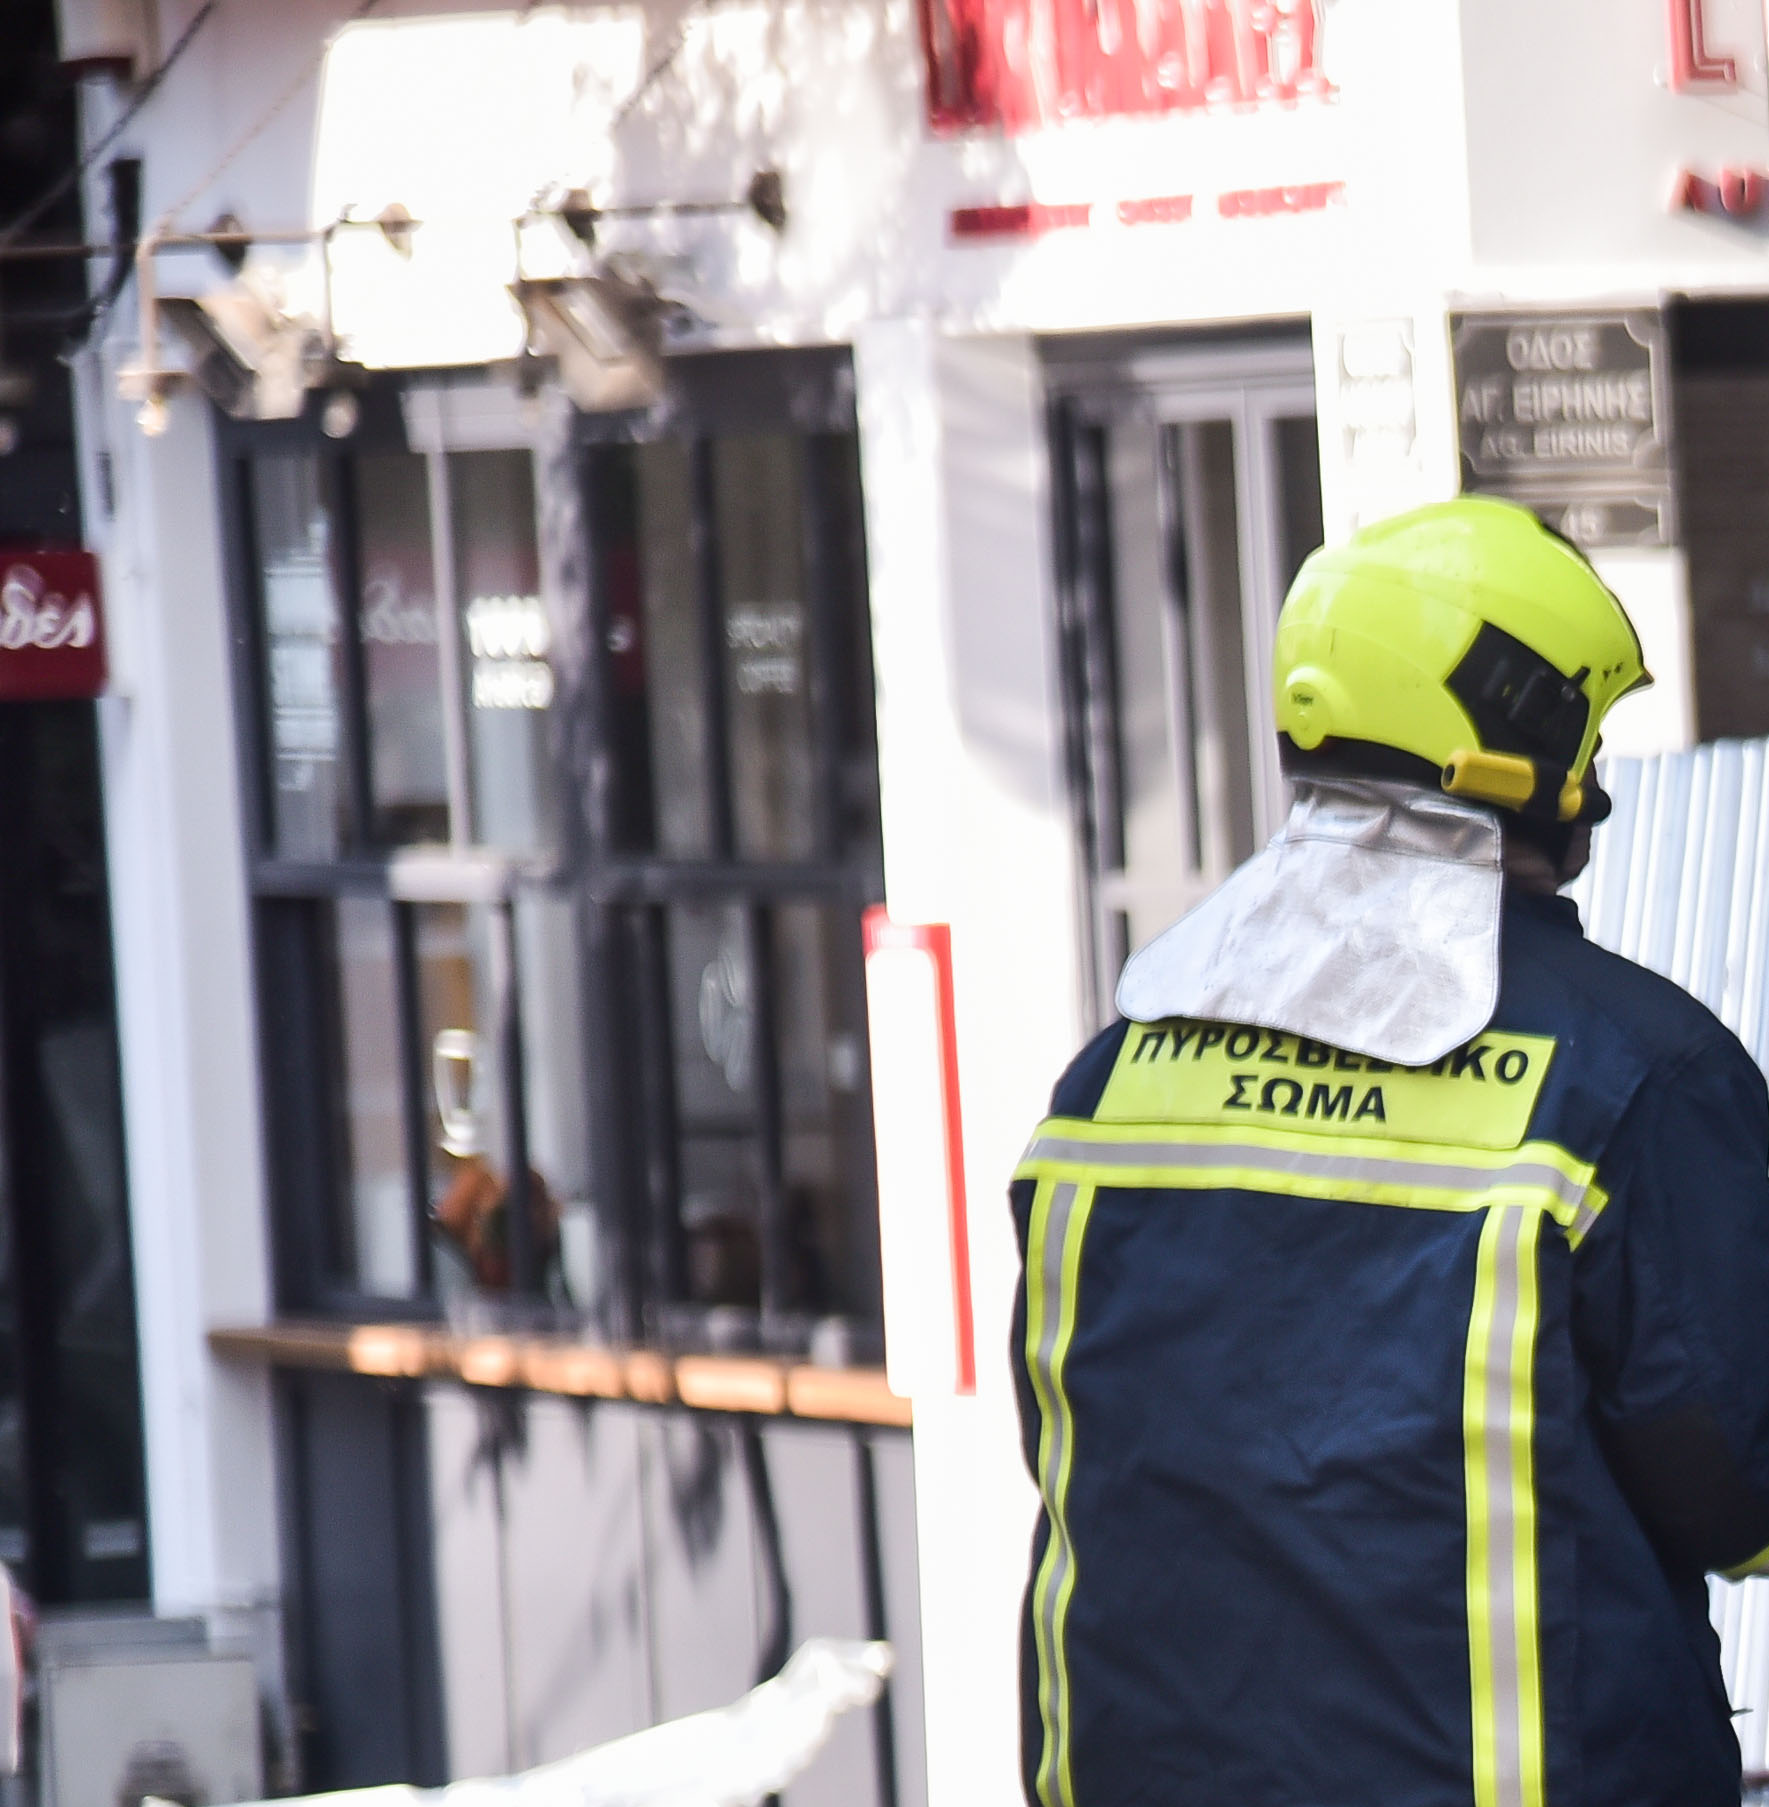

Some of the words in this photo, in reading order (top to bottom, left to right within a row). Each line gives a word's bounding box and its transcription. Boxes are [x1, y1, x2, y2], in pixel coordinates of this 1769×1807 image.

[1505, 330, 1597, 371] ΟΔΟΣ
[1512, 374, 1650, 424] ΕΙΡΗΝΗΣ
[1533, 427, 1632, 459] EIRINIS
[1222, 1073, 1387, 1124] ΣΩΜΑ
